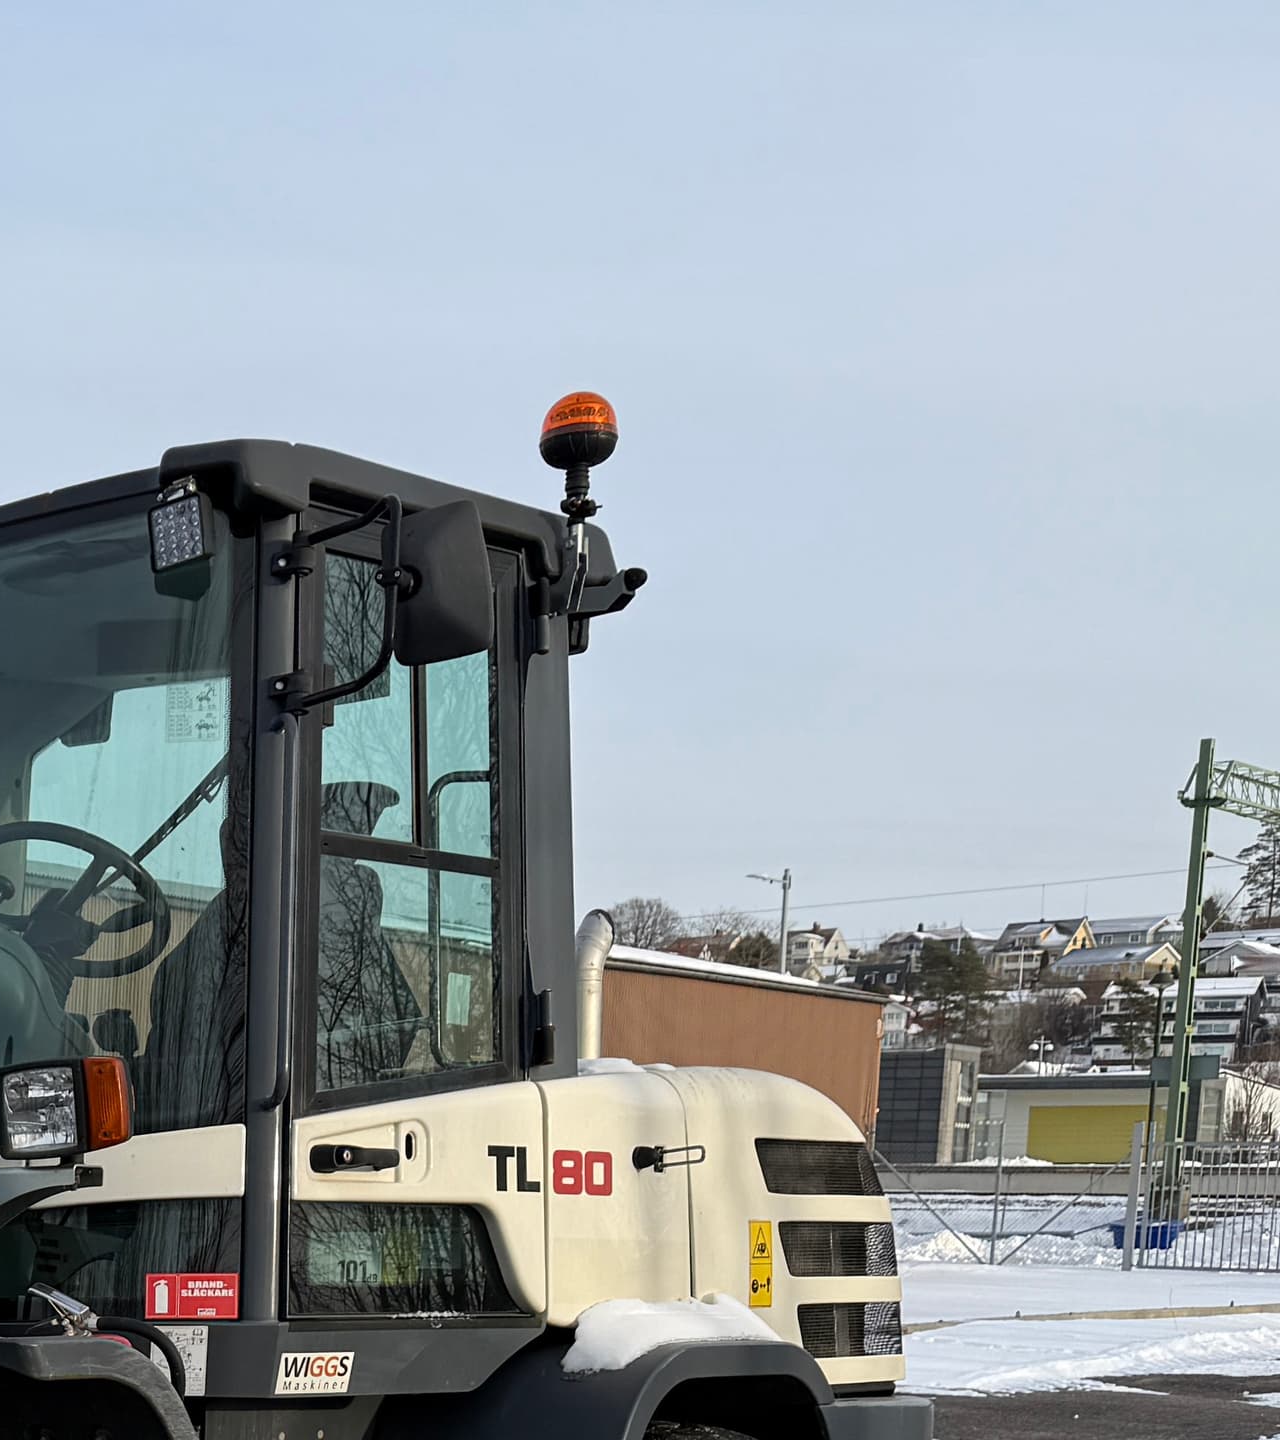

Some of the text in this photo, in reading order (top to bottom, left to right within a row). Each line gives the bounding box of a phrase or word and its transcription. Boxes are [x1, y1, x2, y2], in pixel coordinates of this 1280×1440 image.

[487, 1144, 613, 1197] TL 80
[187, 1280, 228, 1289] BRAND-
[283, 1355, 350, 1378] WIGGS
[282, 1380, 345, 1391] Maskiner
